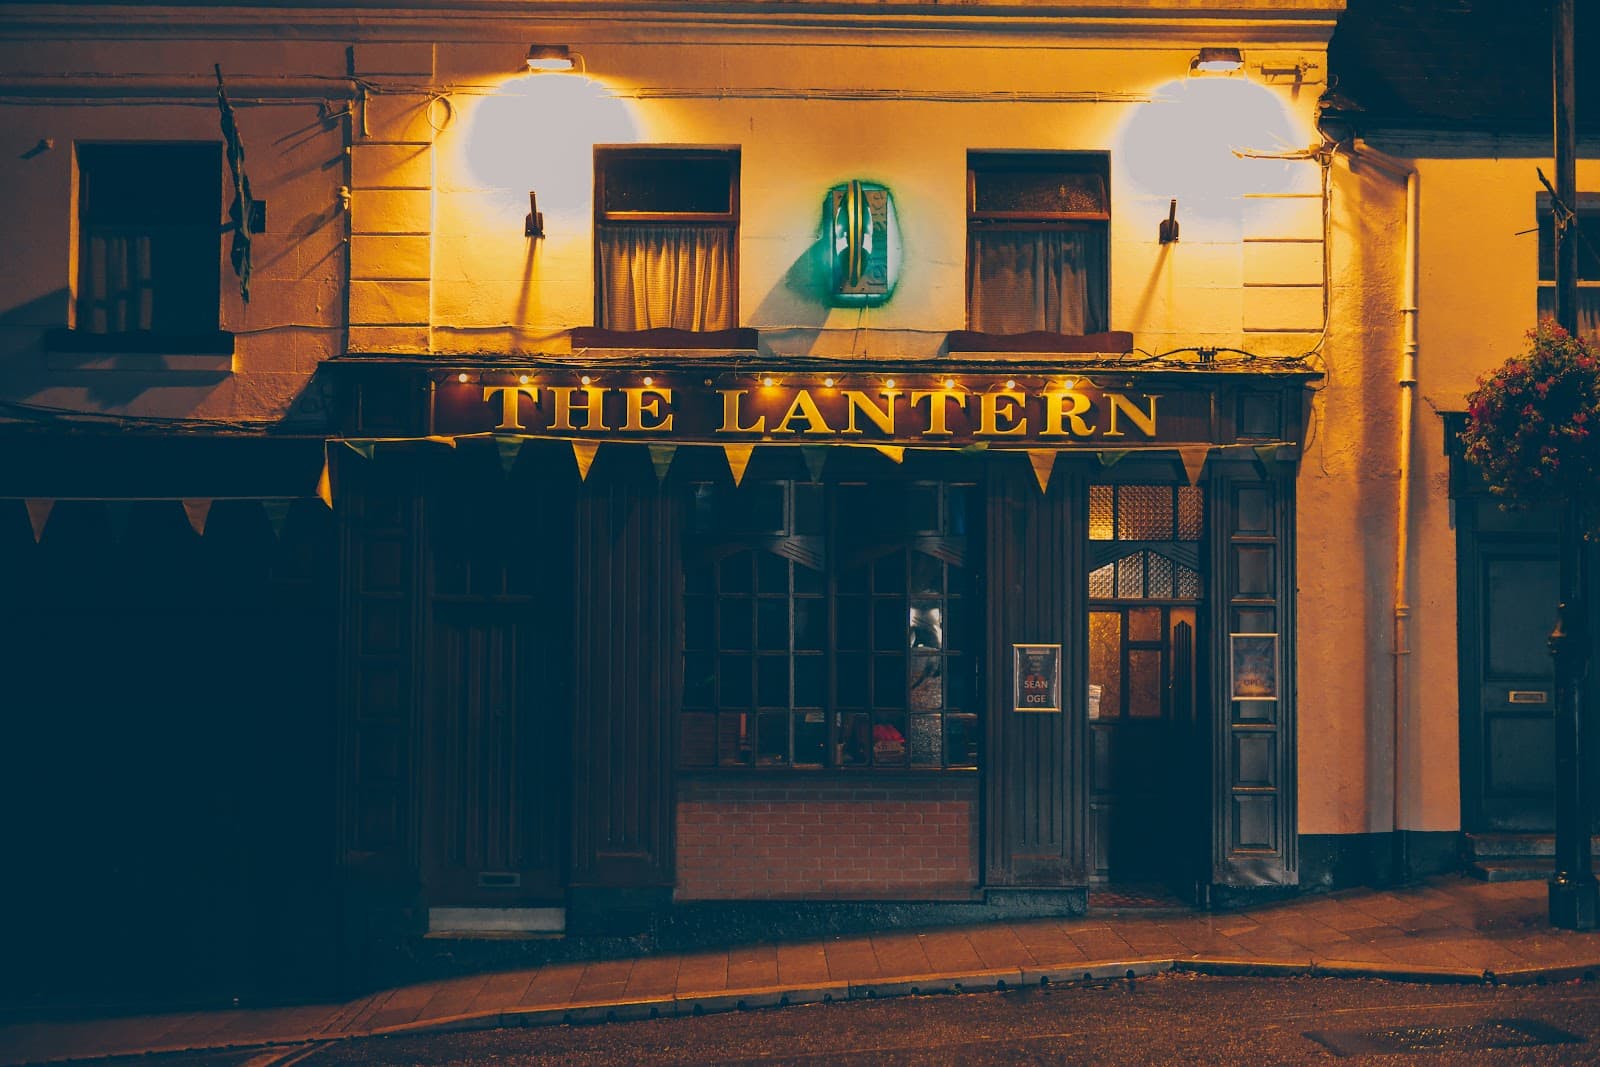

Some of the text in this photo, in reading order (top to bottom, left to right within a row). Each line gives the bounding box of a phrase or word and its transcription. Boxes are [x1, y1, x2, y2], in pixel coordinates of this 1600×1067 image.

[483, 385, 1161, 438] THE LANTERN
[1024, 680, 1048, 689] SEAN
[1026, 694, 1047, 703] OGE
